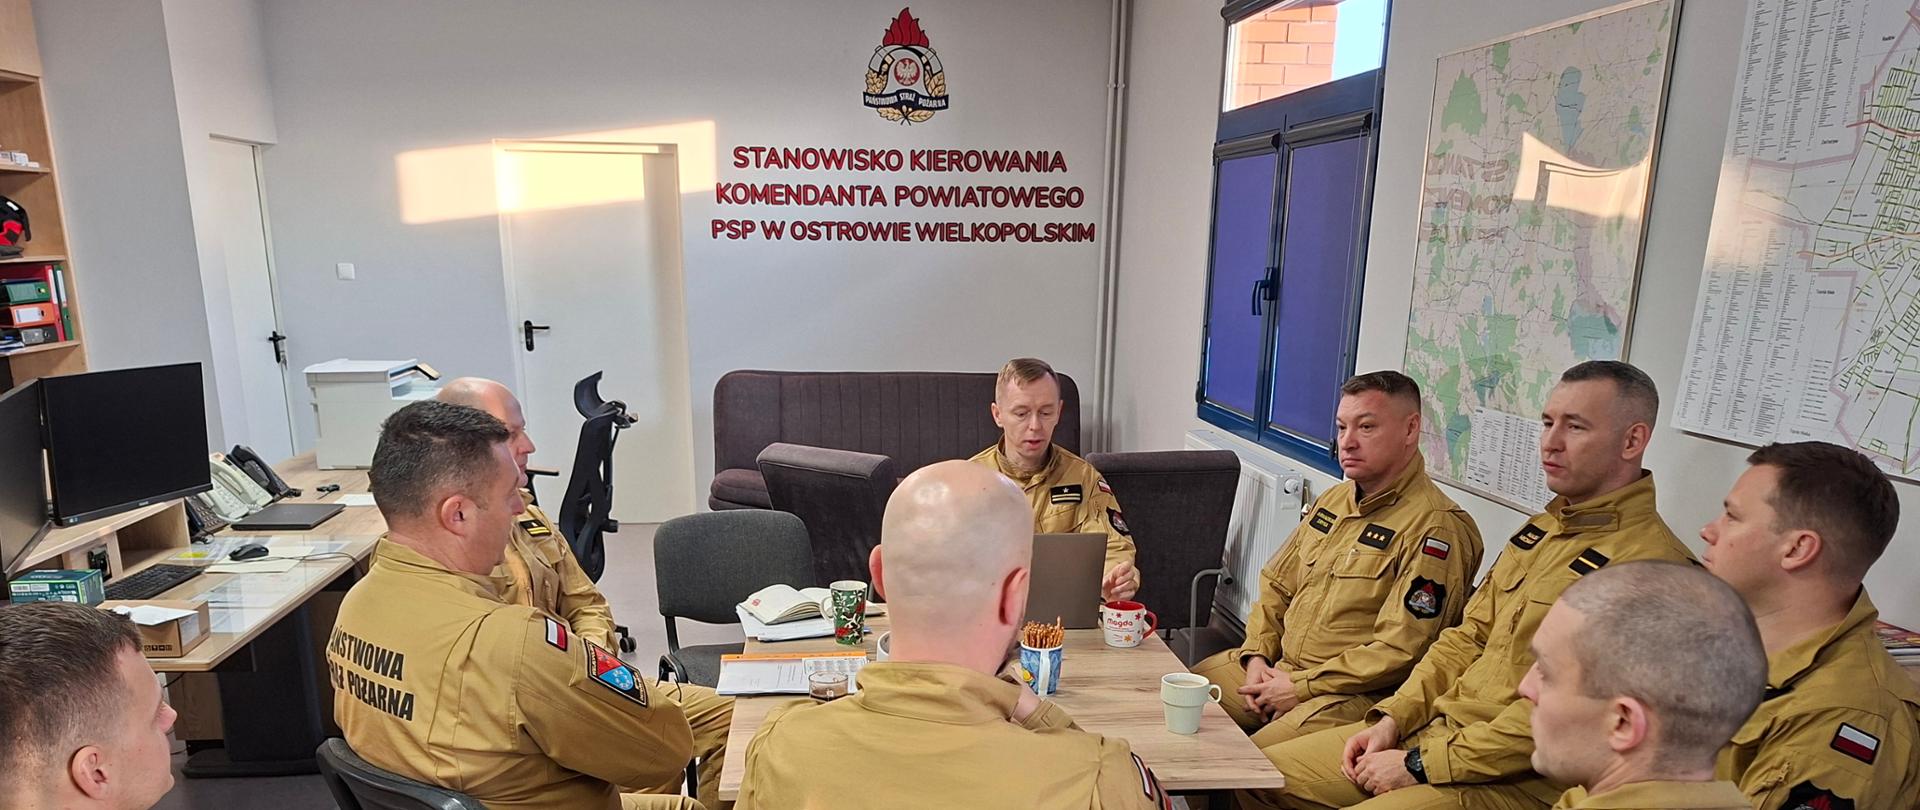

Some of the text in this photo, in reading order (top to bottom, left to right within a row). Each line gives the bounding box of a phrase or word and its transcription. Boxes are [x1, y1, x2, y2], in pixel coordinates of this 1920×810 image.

[734, 146, 1067, 172] STANOWISKO KIEROWANIA
[717, 183, 1084, 208] KOMENDANTA POWIATOWEGO
[712, 220, 1095, 242] PSP W OSTROWIE WIELKOPOLSKIM
[330, 624, 404, 681] AŃSTWOWA
